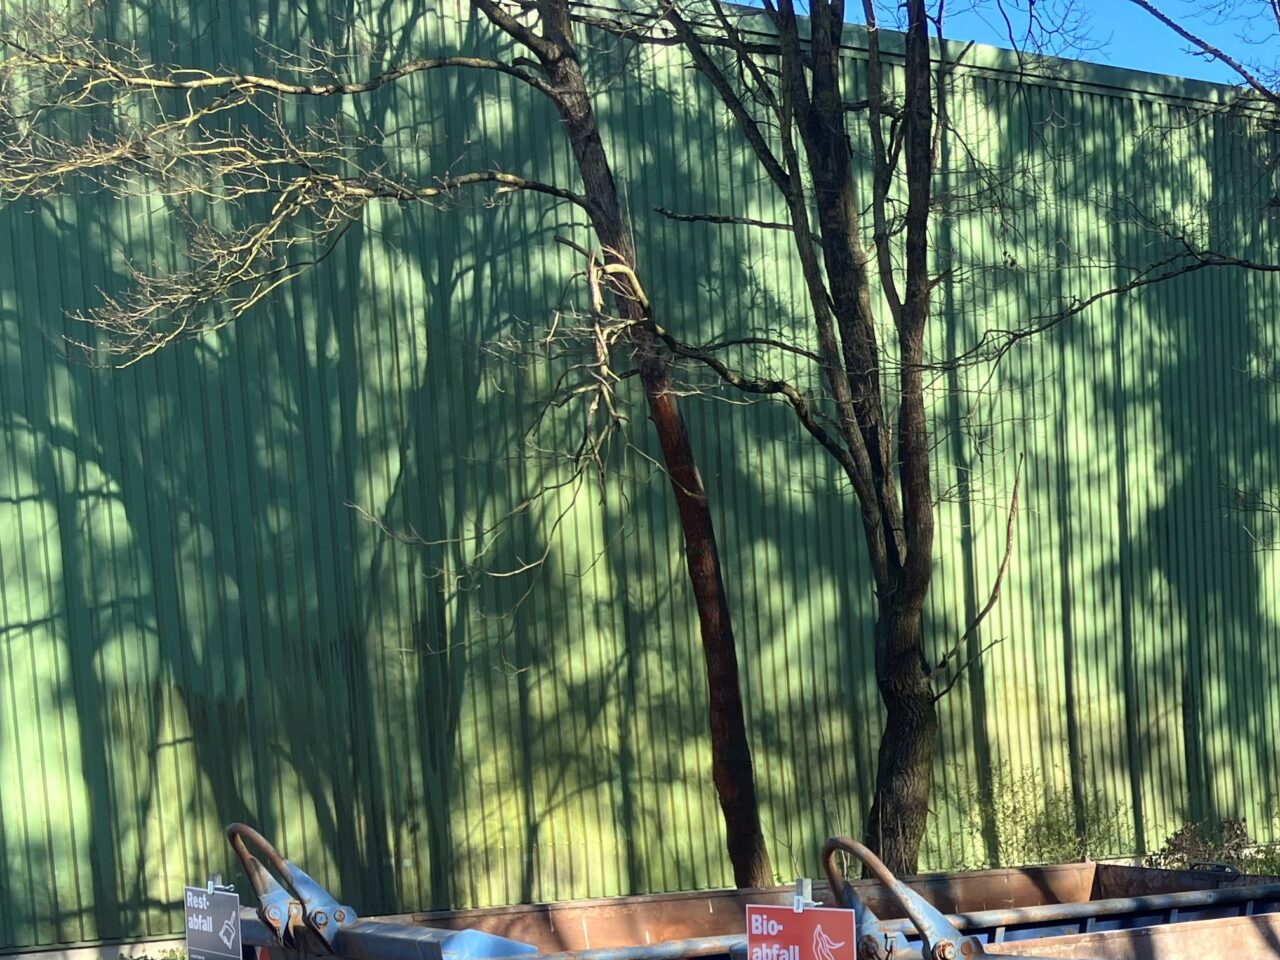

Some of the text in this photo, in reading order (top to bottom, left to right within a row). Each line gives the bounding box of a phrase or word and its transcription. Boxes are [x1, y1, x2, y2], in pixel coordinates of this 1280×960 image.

[186, 891, 210, 910] Rest-
[188, 914, 213, 933] abfall
[751, 914, 783, 936] Bio-
